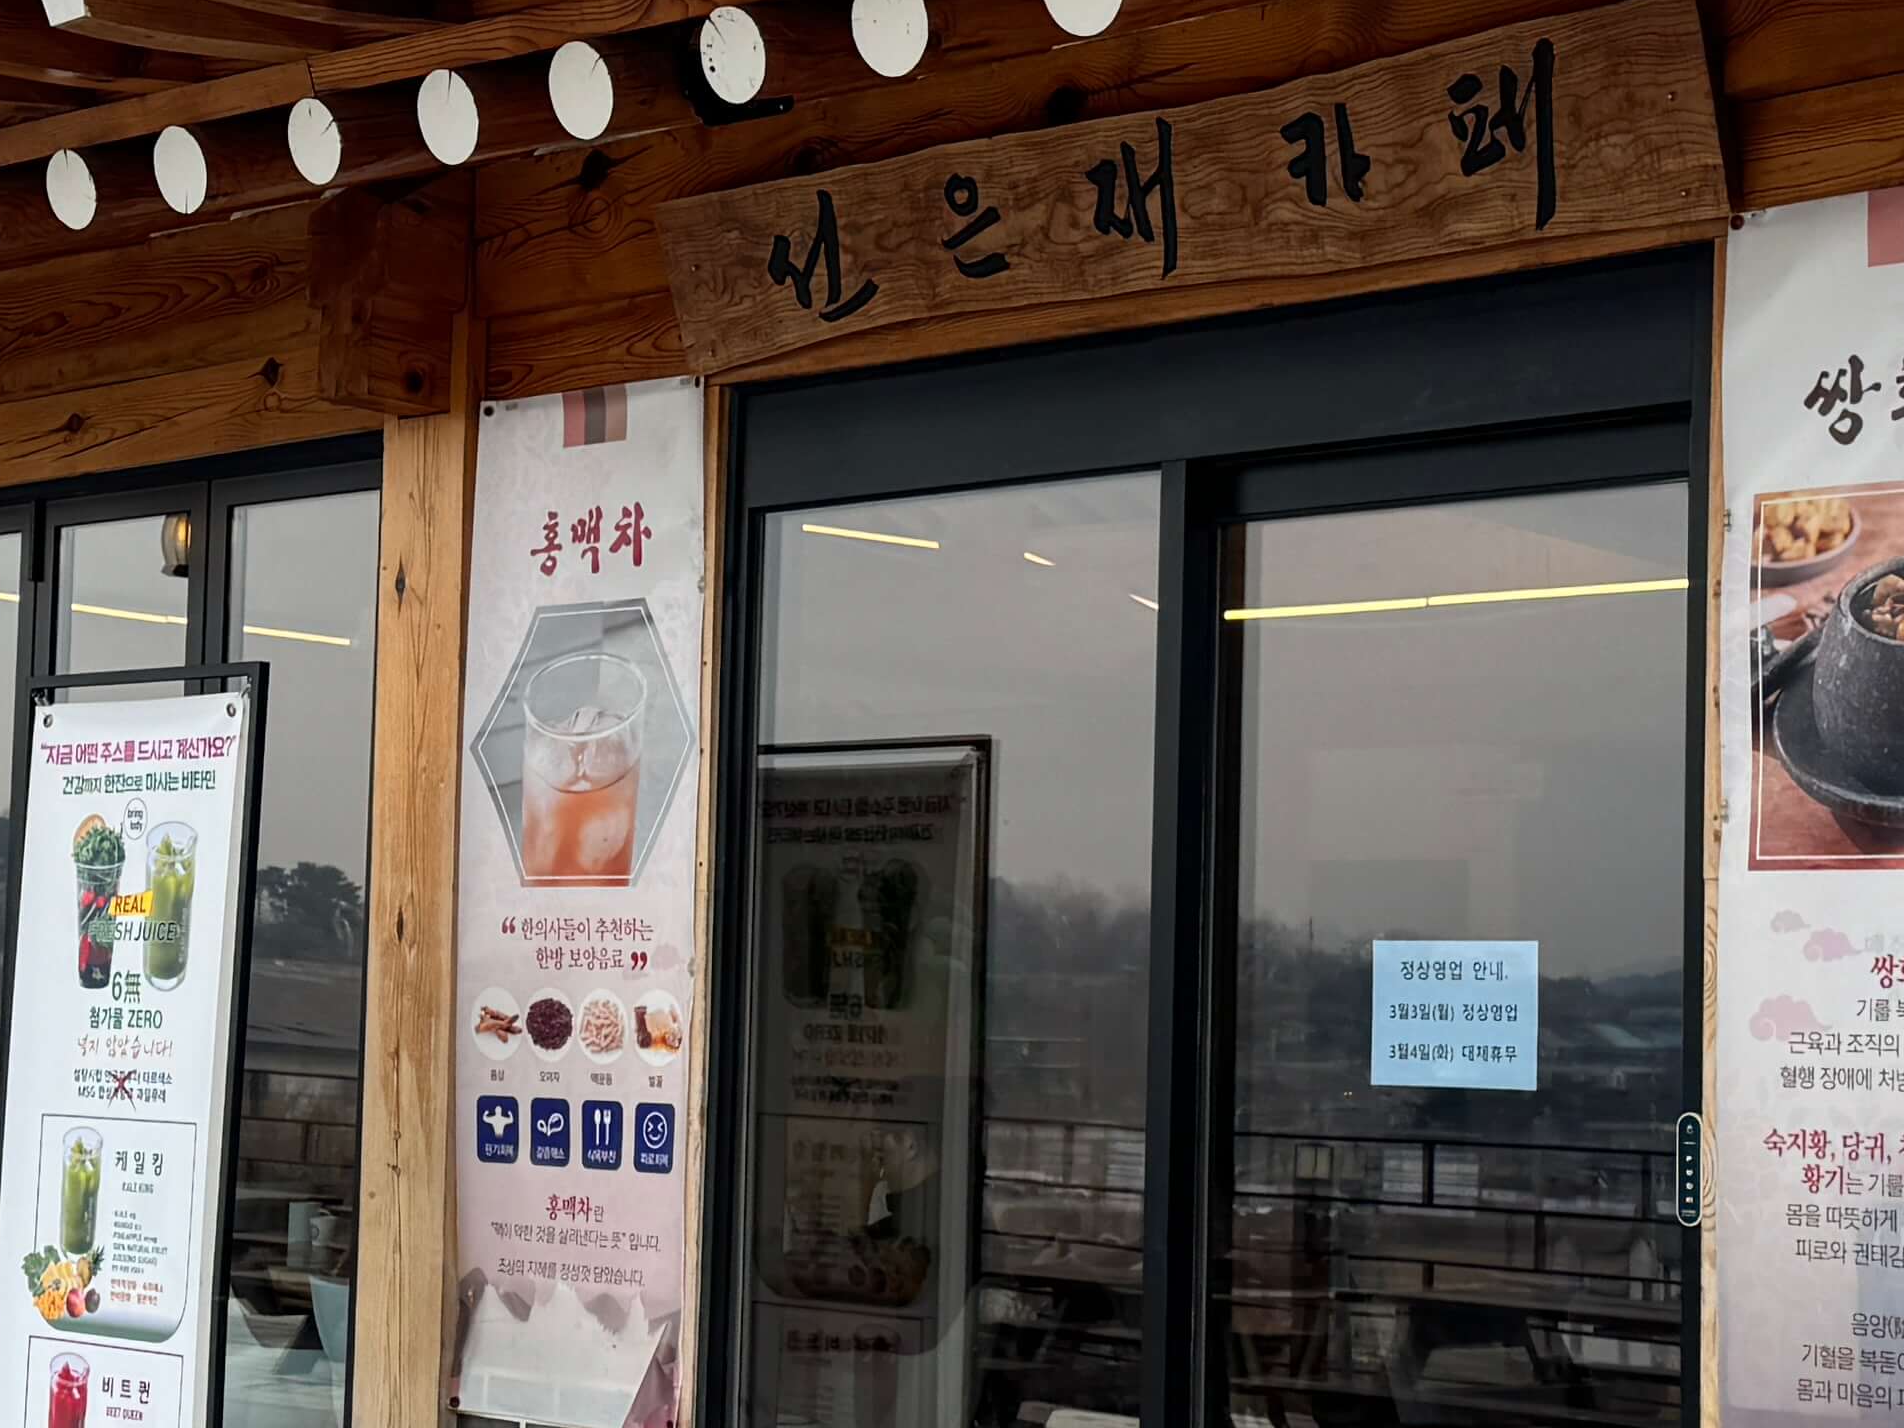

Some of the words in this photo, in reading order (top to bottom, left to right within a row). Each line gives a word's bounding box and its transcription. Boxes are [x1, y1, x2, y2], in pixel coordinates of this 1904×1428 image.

[530, 501, 652, 576] 홍맥차
[75, 743, 98, 764] 어떤
[100, 740, 135, 764] 주스를
[137, 739, 173, 761] 드시고
[104, 774, 144, 794] 한잔으로
[145, 771, 179, 791] 마시는
[181, 769, 216, 790] 비타민
[115, 895, 146, 913] REAL
[134, 922, 177, 941] JUICE
[595, 917, 654, 942] 추천하는
[535, 946, 566, 970] 한방
[1400, 960, 1463, 982] 정상영업
[1473, 960, 1509, 982] 안내.
[89, 1006, 124, 1030] 첨가물
[127, 1009, 163, 1029] ZERO
[1389, 1002, 1455, 1023] 3월3일(월)
[1462, 1003, 1519, 1023] 정상영업
[1856, 998, 1892, 1023] 기를
[1388, 1043, 1455, 1062] 3월4일(화)
[1461, 1044, 1518, 1064] 대체휴무
[1788, 1031, 1841, 1056] 근육과
[1847, 1033, 1900, 1058] 조직의
[1779, 1065, 1816, 1090] 혈행
[1819, 1067, 1873, 1091] 장애에
[1763, 1128, 1836, 1162] 숙지황,
[1842, 1131, 1893, 1165] 당귀,
[1801, 1164, 1864, 1196] 황기는
[1786, 1203, 1821, 1228] 몸을
[1826, 1206, 1897, 1233] 따뜻하게
[535, 1226, 556, 1245] 것을
[558, 1228, 609, 1249] 살려낸다는
[1795, 1238, 1848, 1265] 피로와
[498, 1257, 525, 1277] 조상의
[527, 1260, 557, 1281] 지혜를
[560, 1263, 591, 1283] 정성껏
[593, 1266, 646, 1287] 담았습니다.
[1801, 1343, 1855, 1372] 기혈을
[1796, 1378, 1833, 1404] 몸과
